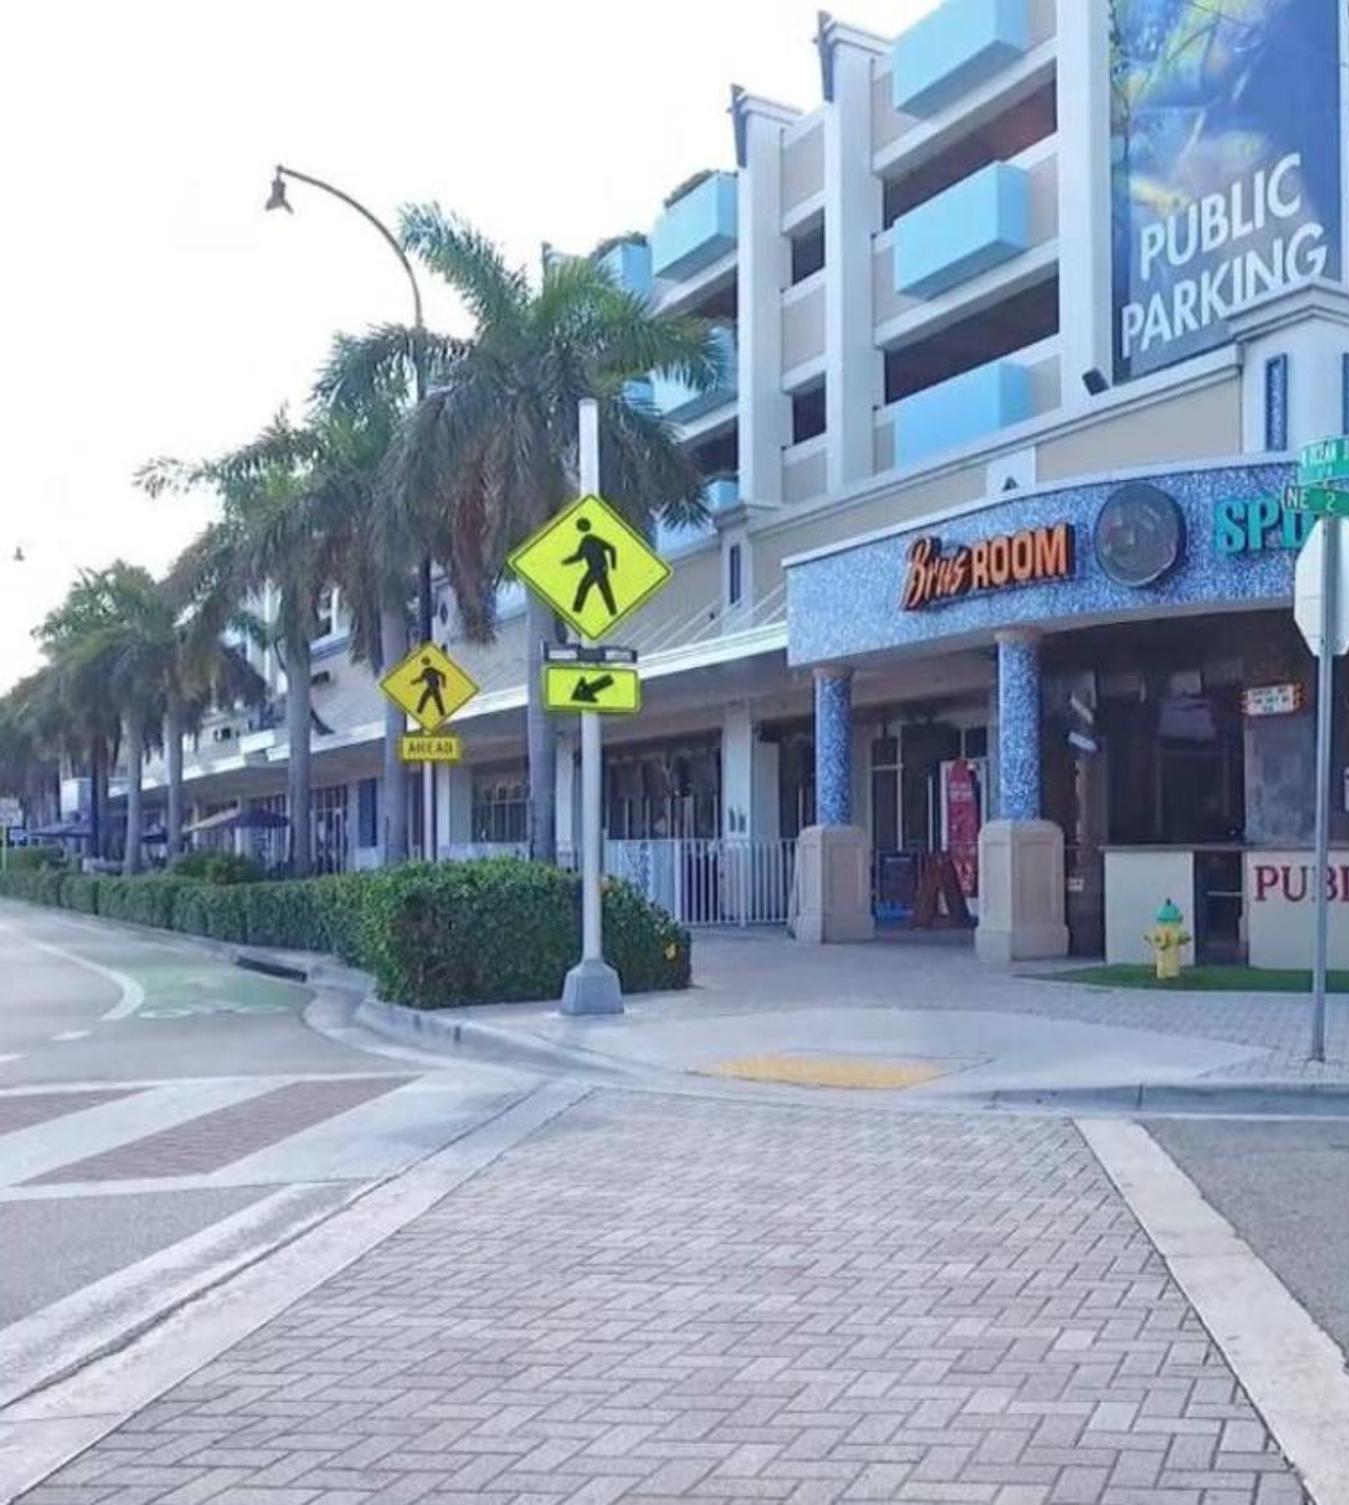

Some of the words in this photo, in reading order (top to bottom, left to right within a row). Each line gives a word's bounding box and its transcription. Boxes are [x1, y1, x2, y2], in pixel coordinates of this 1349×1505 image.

[1140, 152, 1301, 281] PUBLIC
[1121, 222, 1327, 360] PARKING
[1286, 486, 1309, 510] NE
[1325, 491, 1336, 512] 2
[969, 522, 1069, 589] ROOM
[408, 740, 454, 755] AHEAD
